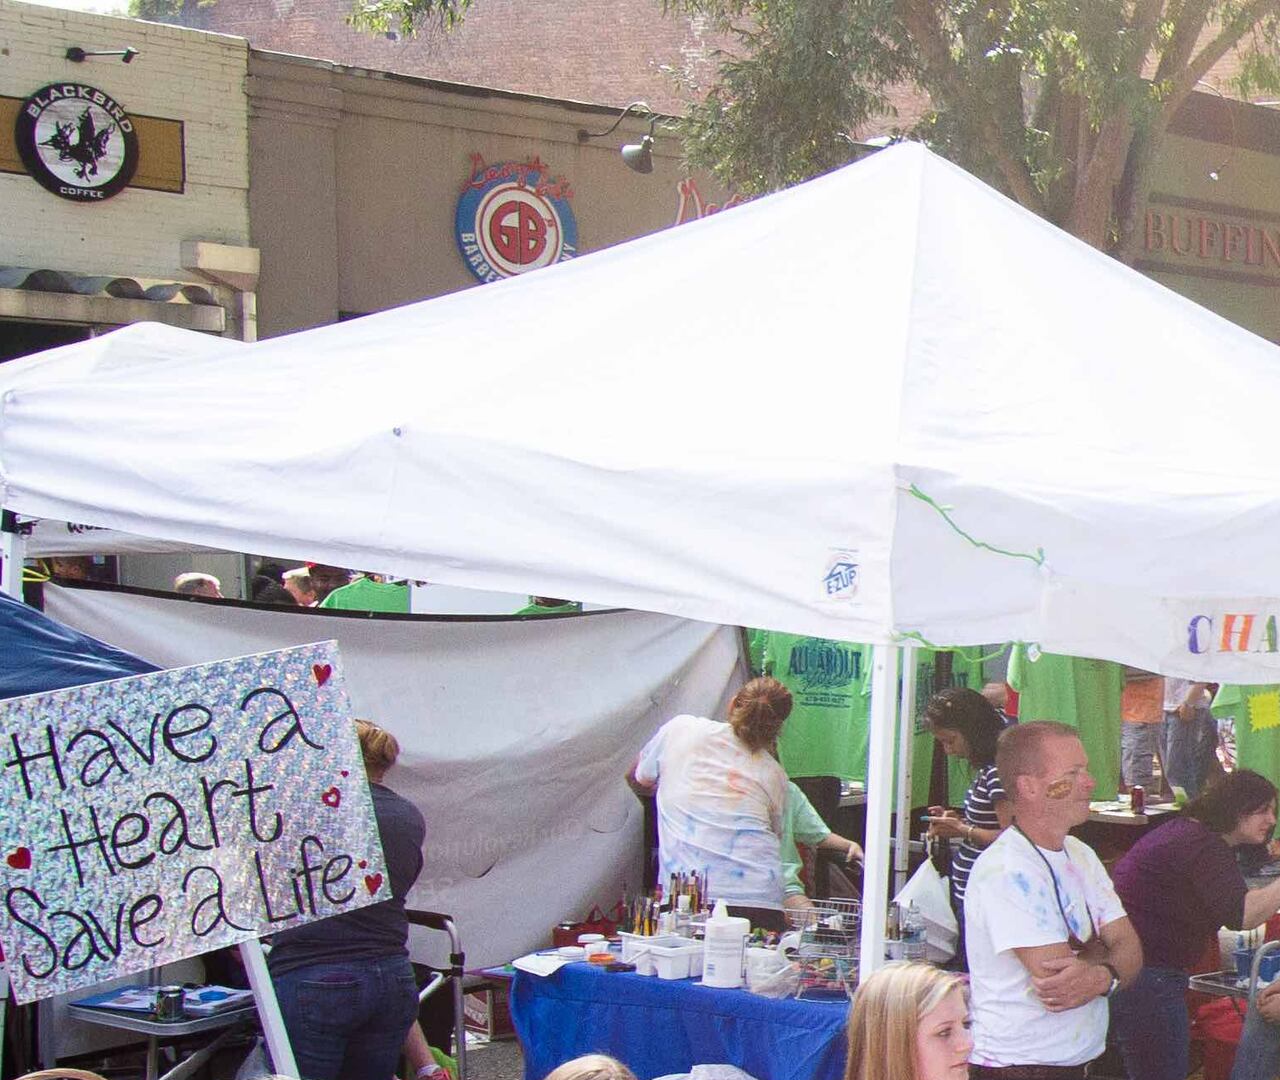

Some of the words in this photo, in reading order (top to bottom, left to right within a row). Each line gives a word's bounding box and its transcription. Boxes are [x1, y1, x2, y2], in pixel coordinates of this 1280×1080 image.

[27, 85, 133, 134] BLACKBIRD
[60, 186, 105, 199] COFFEE
[5, 703, 218, 799] Have
[240, 687, 325, 754] a
[48, 758, 283, 888] Heart
[4, 886, 166, 979] Save
[181, 865, 257, 938] a
[252, 835, 357, 925] Life
